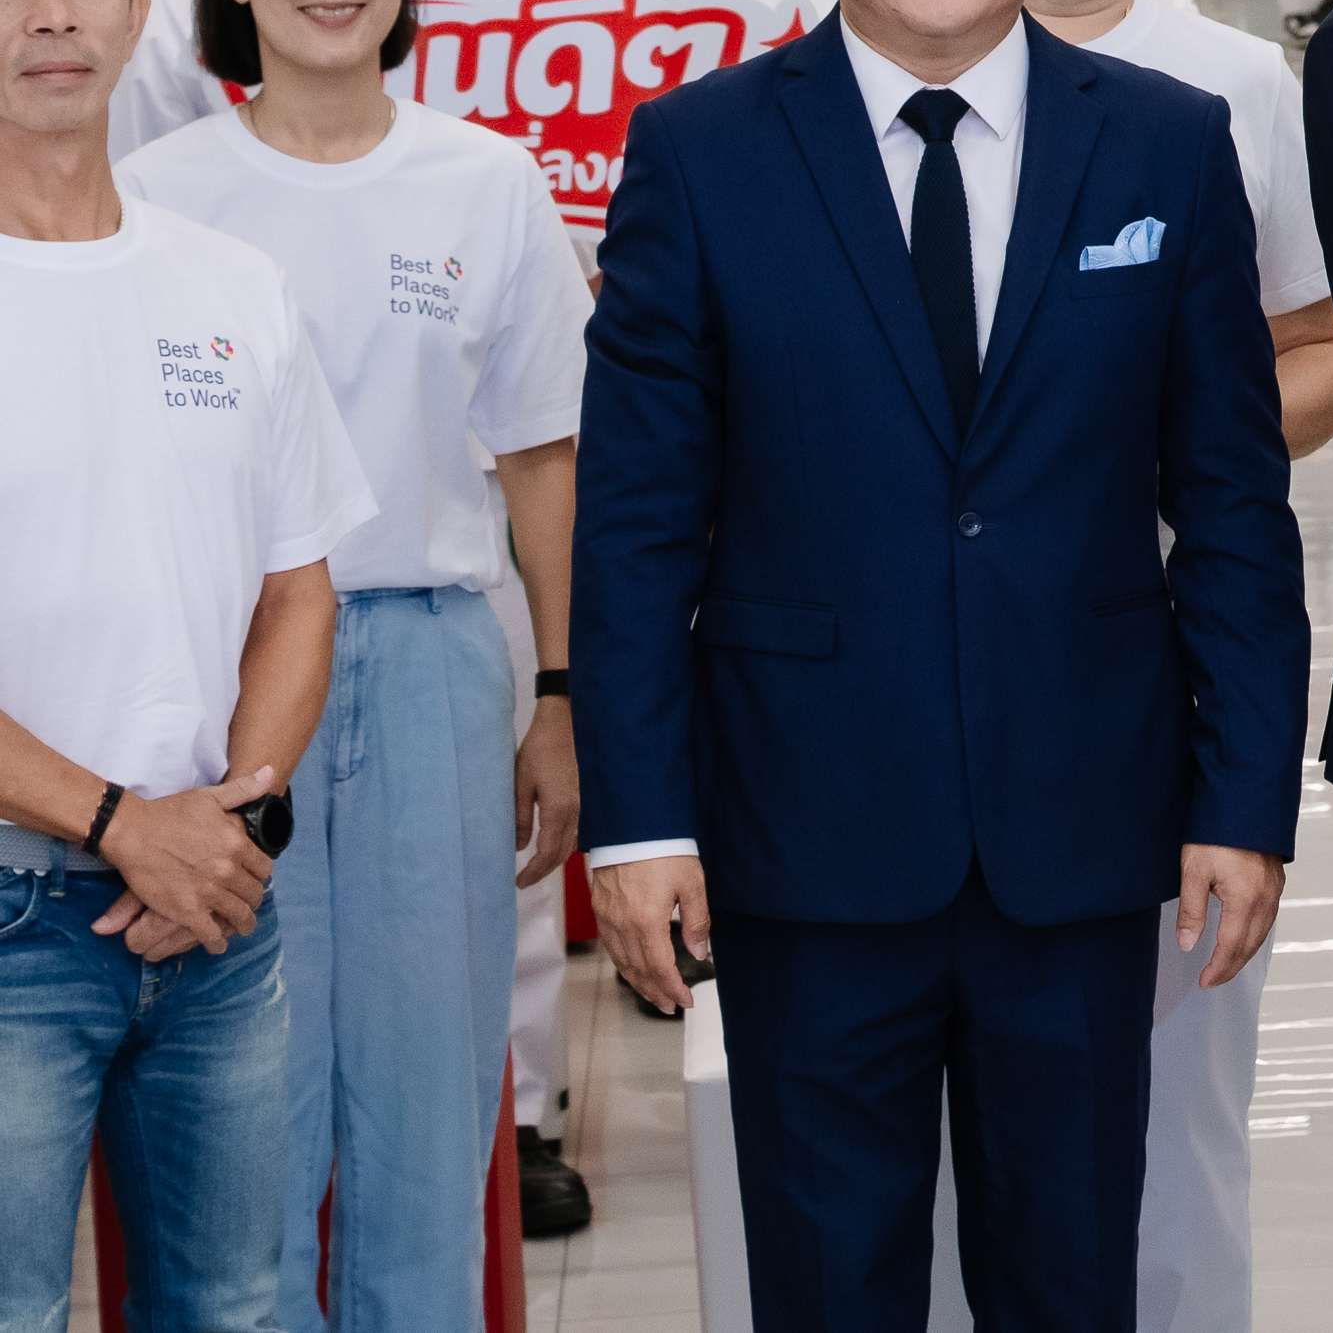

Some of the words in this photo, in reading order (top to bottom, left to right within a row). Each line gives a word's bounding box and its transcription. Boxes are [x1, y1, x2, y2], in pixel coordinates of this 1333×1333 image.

[390, 254, 433, 274] Best
[390, 275, 450, 300] Places
[390, 298, 411, 314] to
[157, 338, 201, 359] Best
[161, 363, 224, 384] Places
[164, 388, 187, 407] to
